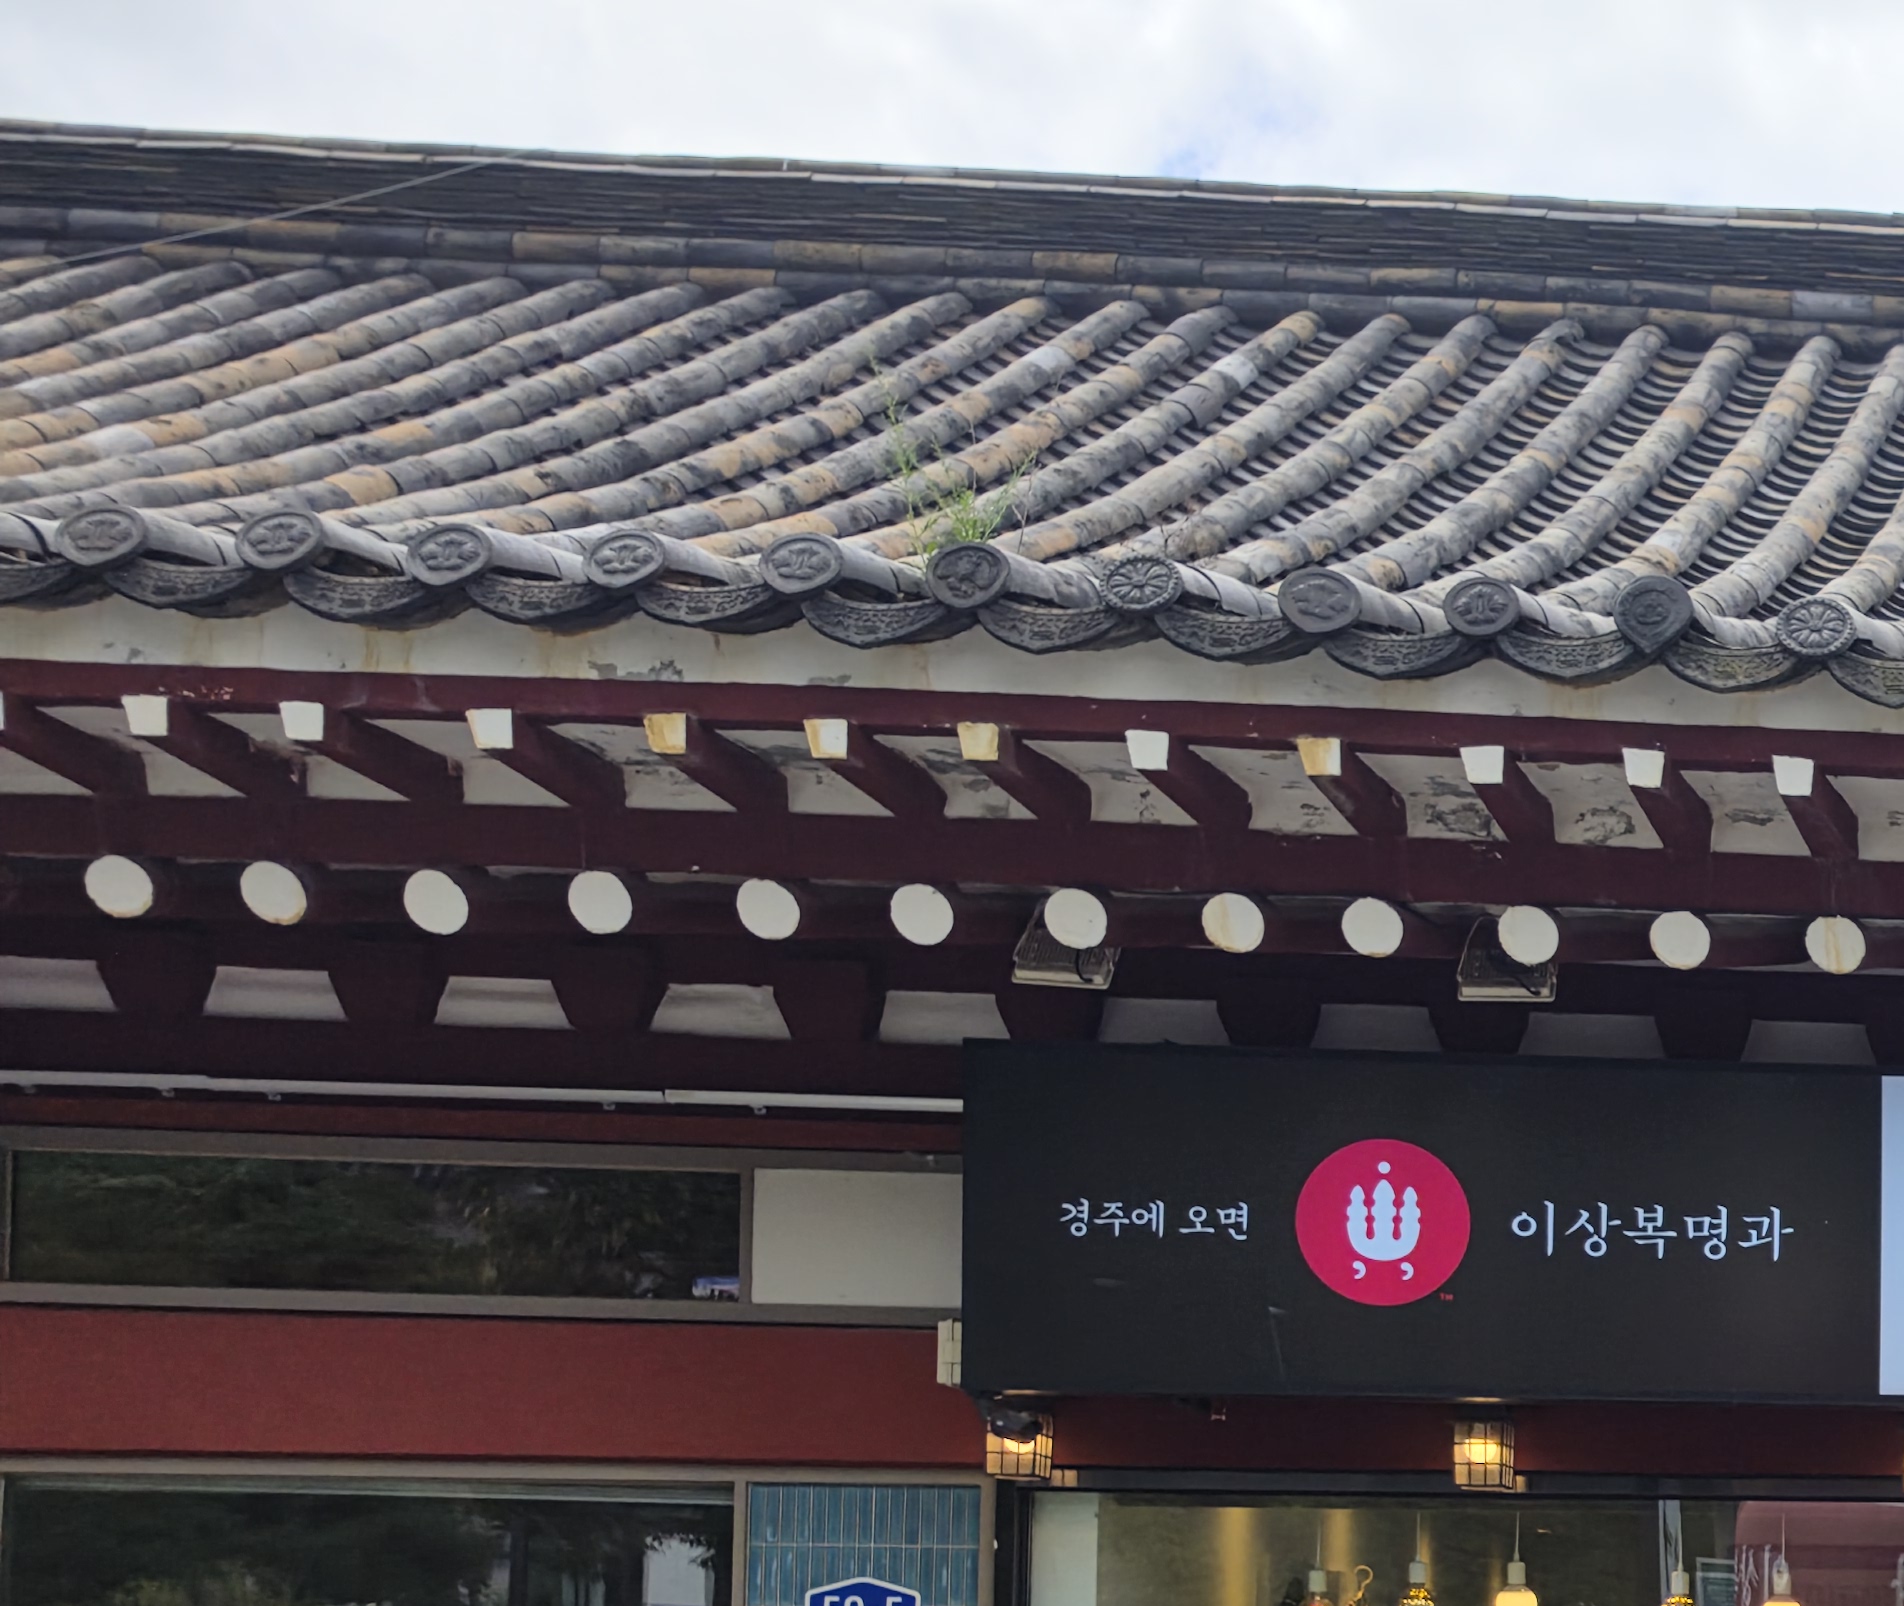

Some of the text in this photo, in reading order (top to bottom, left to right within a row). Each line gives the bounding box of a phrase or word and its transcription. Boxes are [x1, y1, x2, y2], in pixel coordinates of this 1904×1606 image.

[1060, 1198, 1248, 1241] 경주에 오면
[1511, 1200, 1794, 1262] 이상복명과
